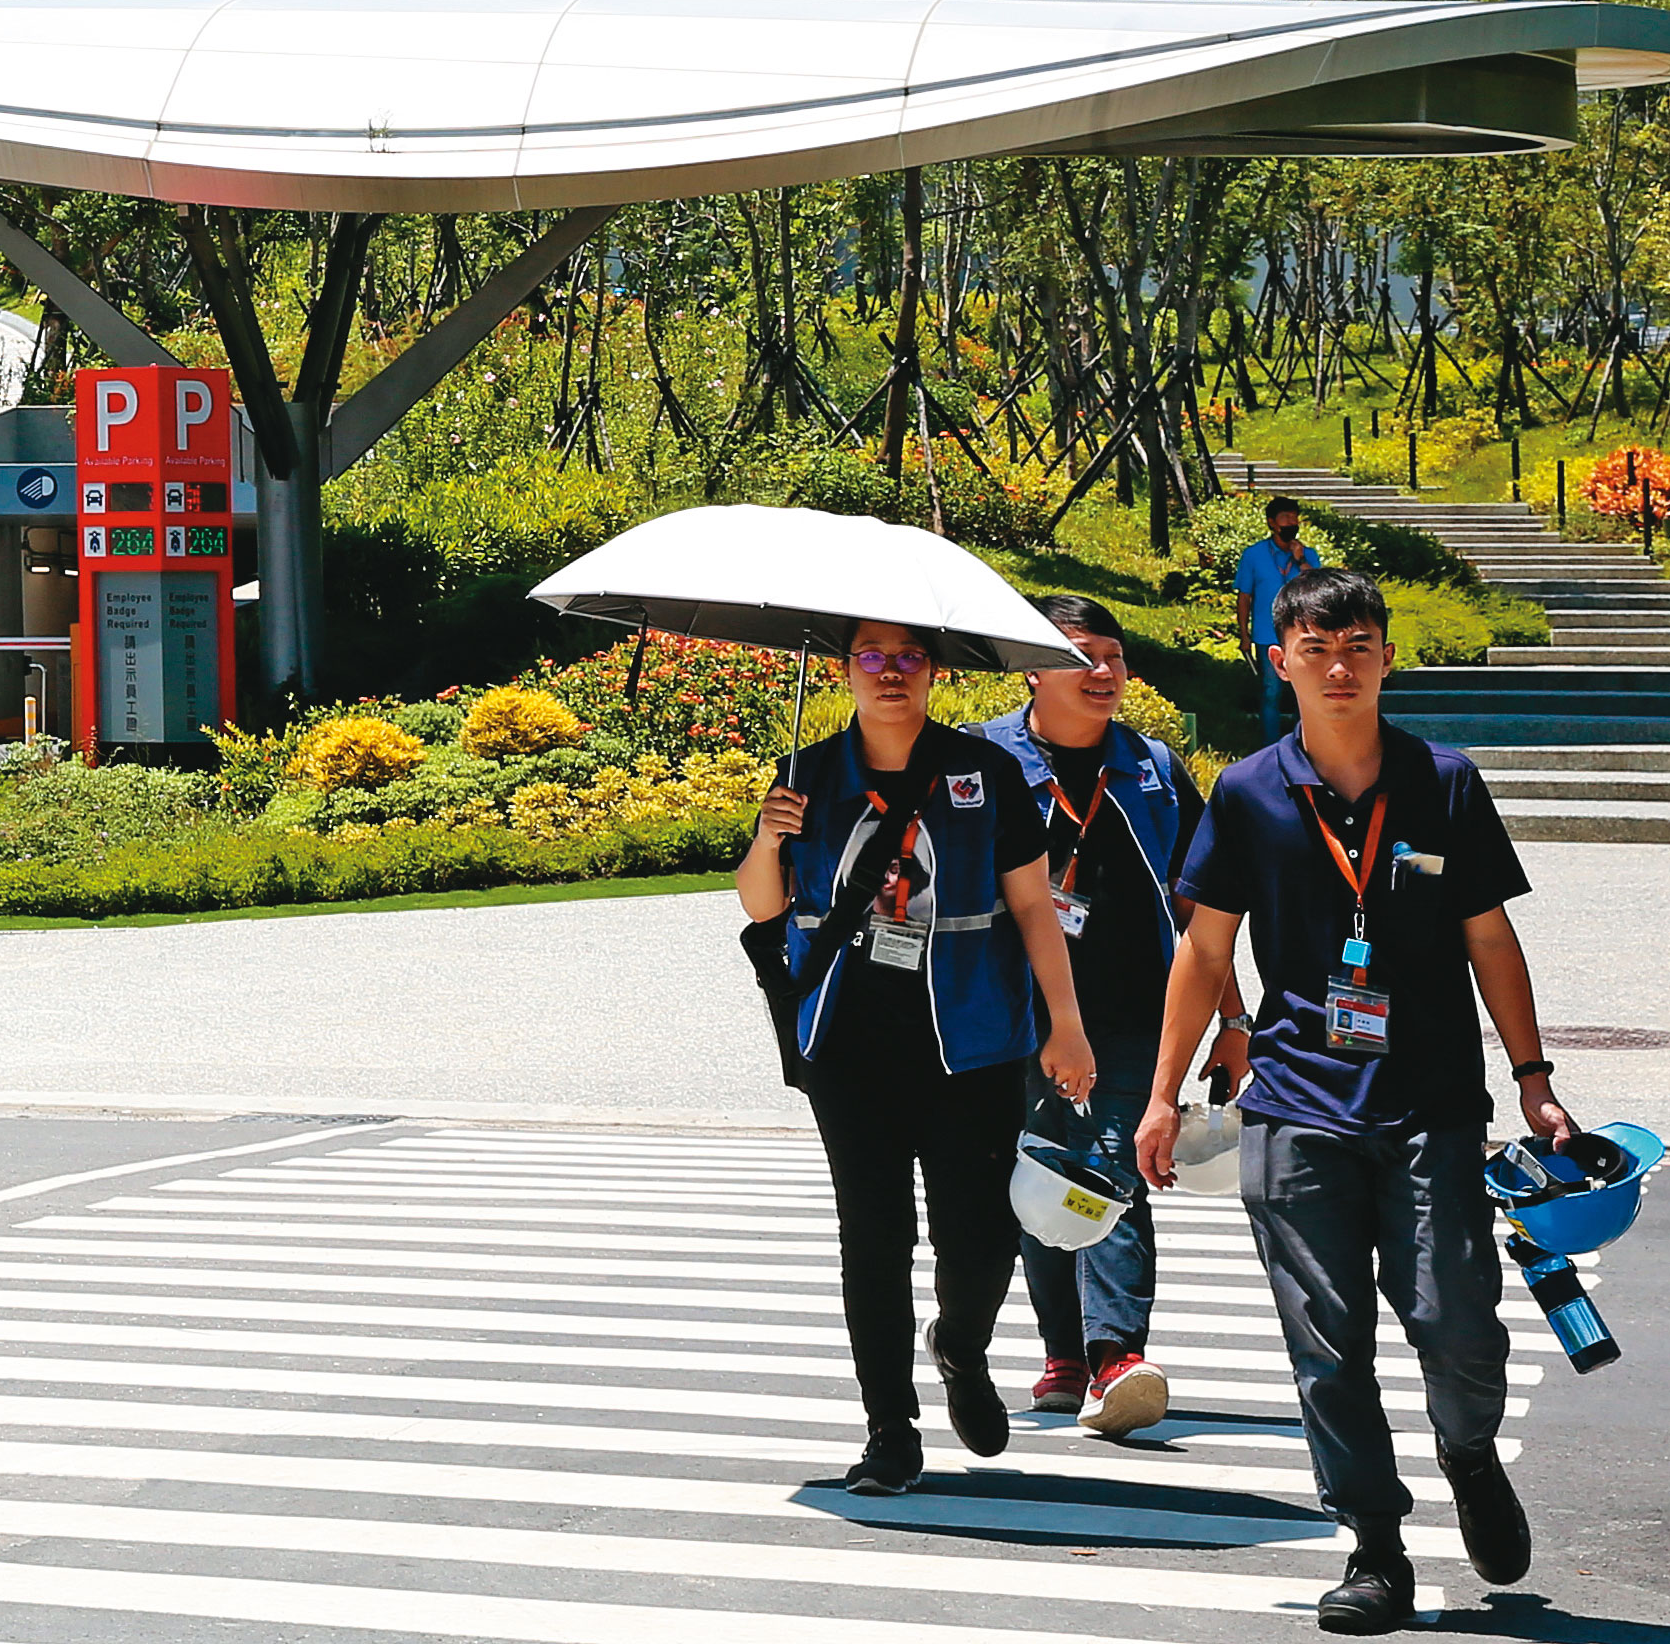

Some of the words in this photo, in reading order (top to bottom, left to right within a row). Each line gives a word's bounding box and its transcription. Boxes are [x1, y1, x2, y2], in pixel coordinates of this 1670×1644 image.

[96, 380, 138, 452] P
[175, 379, 213, 451] P
[84, 457, 120, 466] Available
[122, 456, 154, 467] Parking
[165, 456, 198, 466] Available
[200, 456, 226, 467] Parking
[111, 529, 154, 555] 264
[188, 528, 224, 554] 264
[106, 592, 152, 604] Employee
[106, 605, 137, 617] Badge
[107, 619, 150, 630] Required
[124, 635, 137, 732] 請出示員工
